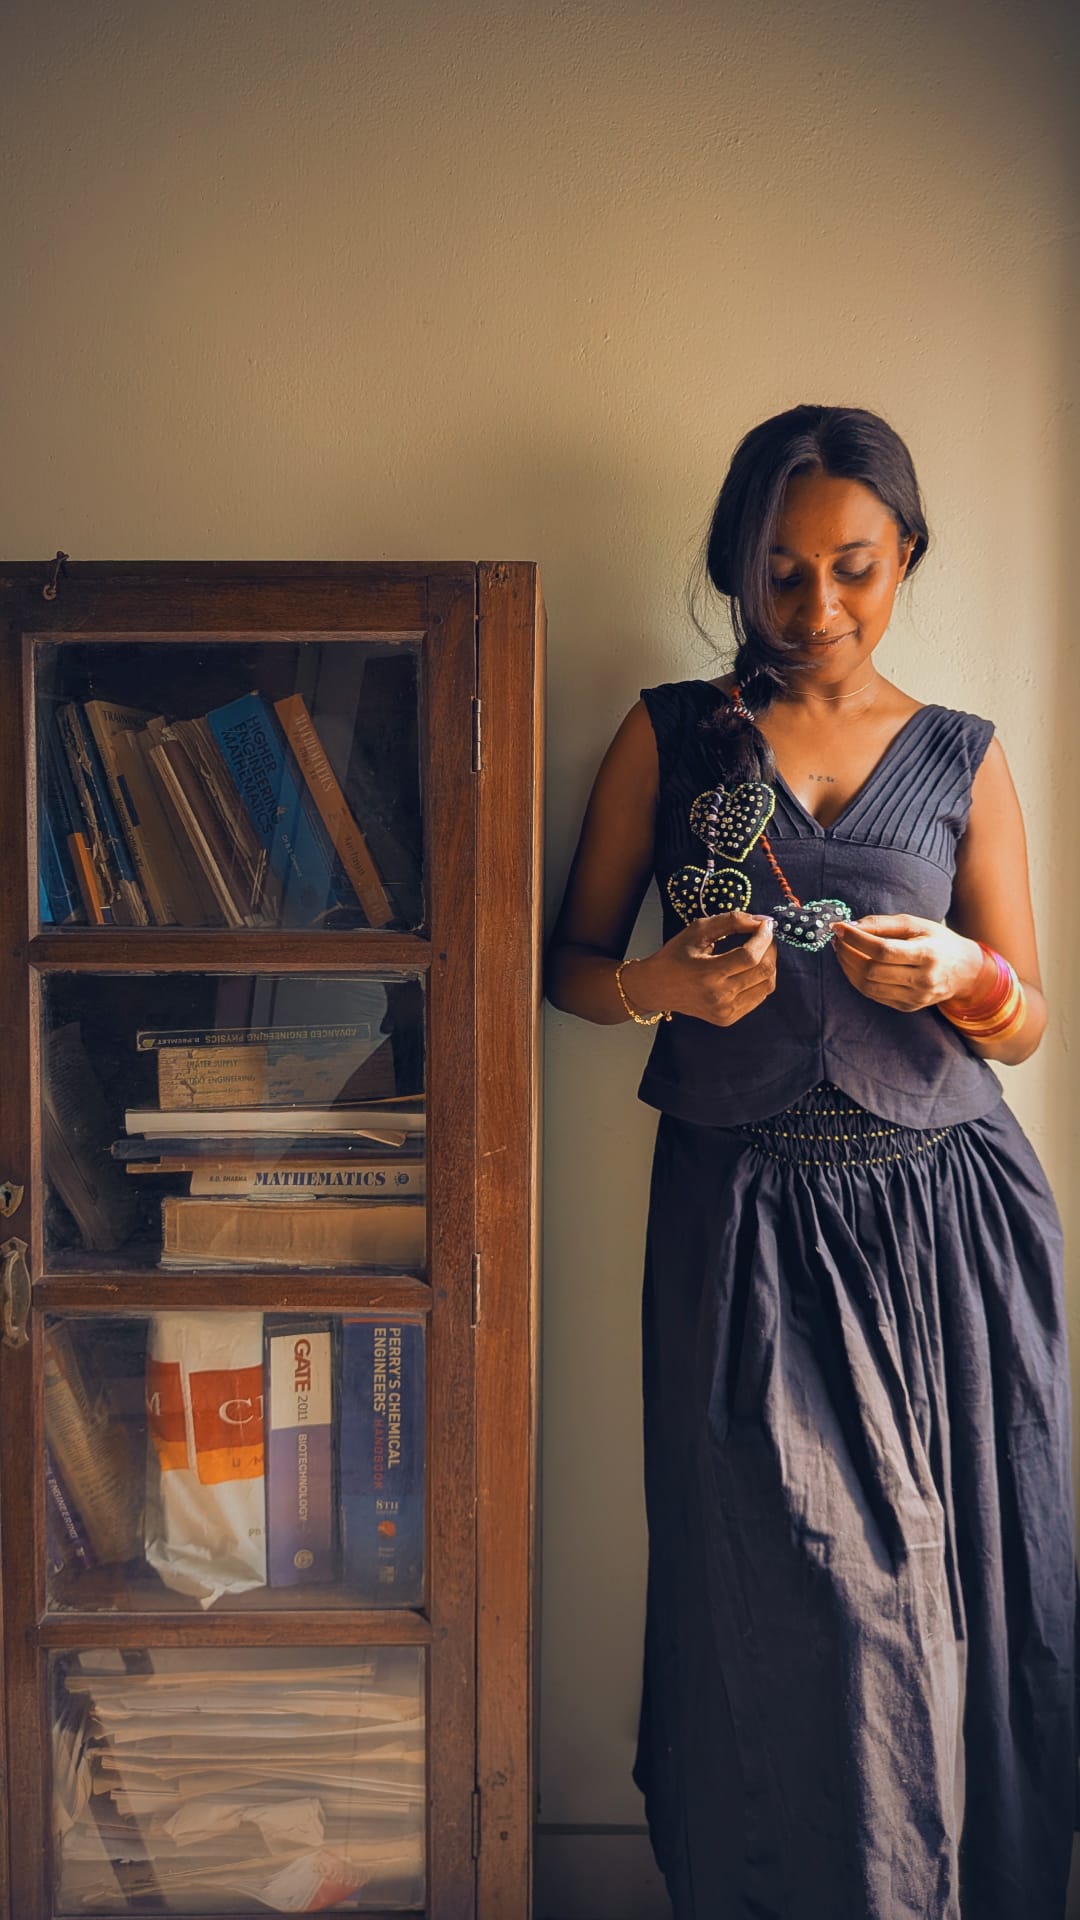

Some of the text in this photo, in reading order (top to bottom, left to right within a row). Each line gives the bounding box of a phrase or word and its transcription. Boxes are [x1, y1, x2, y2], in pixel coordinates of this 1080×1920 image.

[234, 721, 281, 825] ENGINEERING
[248, 714, 278, 775] HIGHER
[221, 727, 273, 835] MATHEMATICS
[204, 1032, 245, 1043] PHYSICS
[213, 1059, 240, 1068] SUPPLY
[247, 1029, 309, 1042] ENGINEERING
[311, 1027, 358, 1039] ADVANCED
[207, 1074, 256, 1085] ENGINEERING
[222, 1175, 248, 1183] SHARMA
[253, 1171, 387, 1187] MATHEMATICS
[294, 1338, 312, 1422] GATE 2011
[373, 1327, 387, 1489] ENGINEERS' HANDBOOK
[387, 1327, 402, 1469] PERRY'S CHEMICAL
[298, 1433, 308, 1521] BIOTECHNOLOGY
[48, 1478, 79, 1539] ENGINEERING
